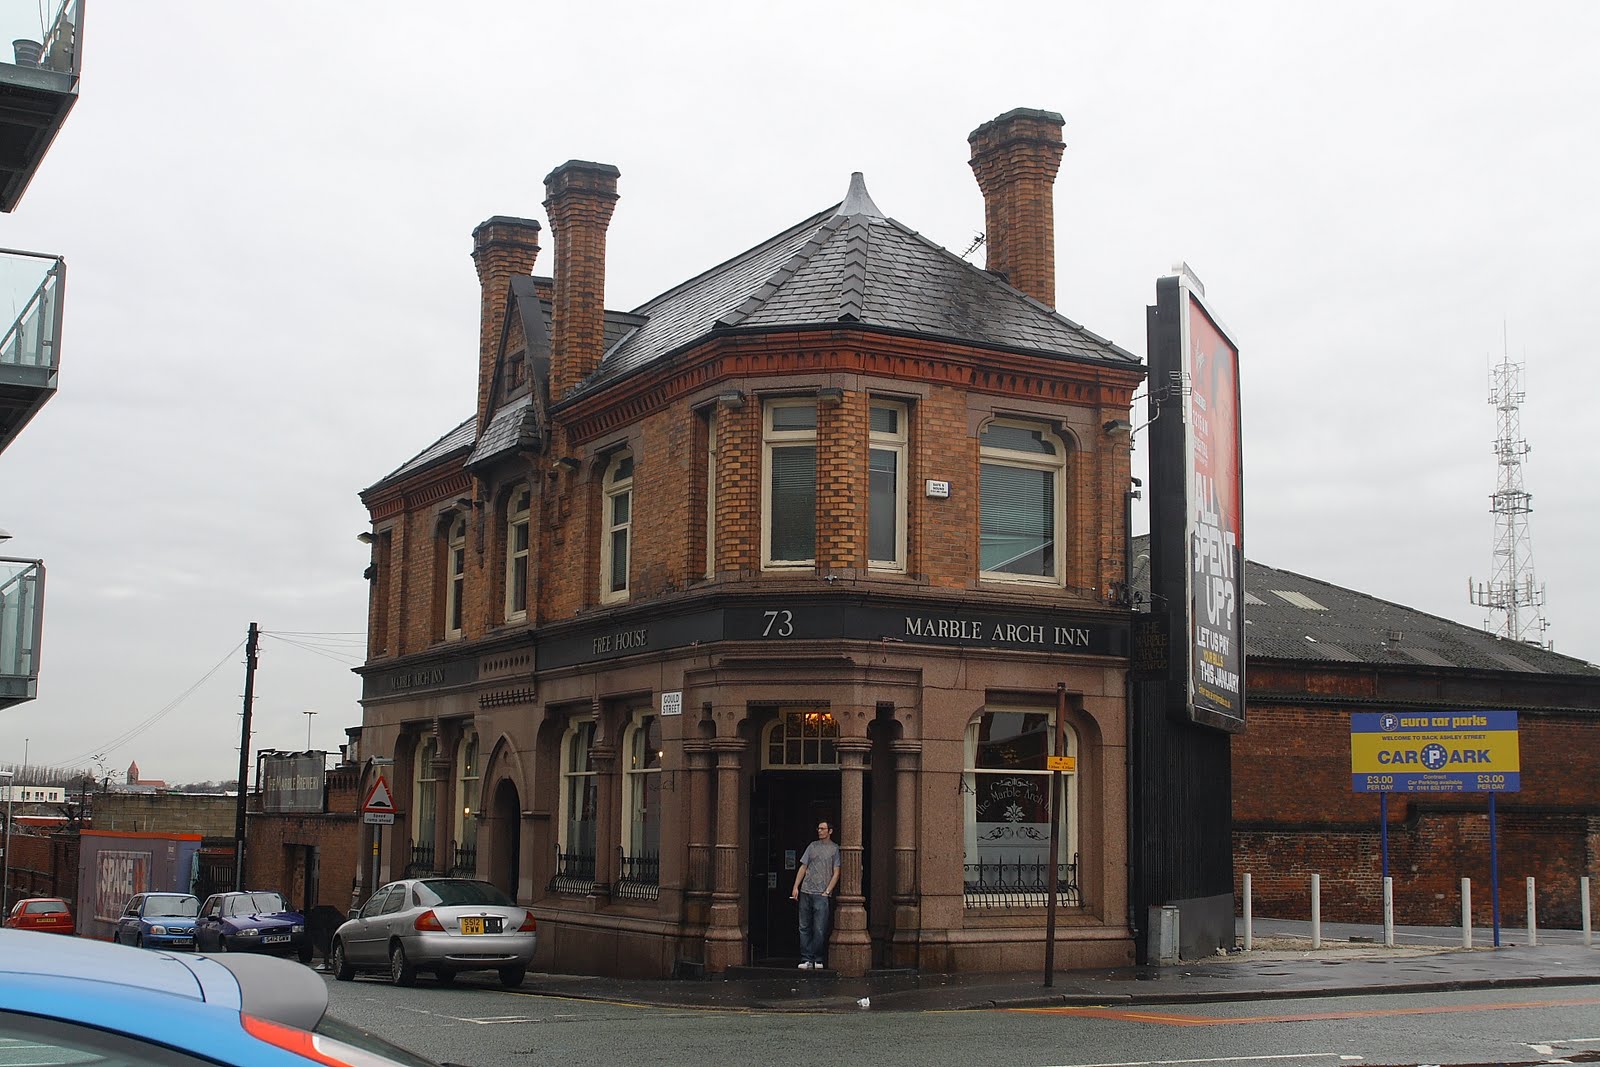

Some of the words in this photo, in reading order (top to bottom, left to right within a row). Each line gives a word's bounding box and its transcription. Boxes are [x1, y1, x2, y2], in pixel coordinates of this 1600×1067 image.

[1195, 472, 1218, 527] ALL
[1195, 521, 1236, 579] SPENT
[1206, 576, 1235, 630] UP?
[762, 610, 794, 637] 73
[905, 616, 982, 640] MARBLE
[991, 623, 1045, 644] ARCH
[1053, 626, 1091, 646] INN
[592, 635, 612, 654] FREE
[615, 629, 647, 651] HOUSE
[1197, 625, 1210, 649] LET
[1210, 630, 1219, 653] US
[1219, 633, 1230, 656] PAY
[1200, 659, 1215, 685] THIS
[662, 703, 680, 714] STREET
[663, 694, 680, 704] GOULD
[1400, 717, 1428, 727] euro
[1431, 717, 1449, 727] car
[1452, 714, 1487, 729] parks
[1377, 750, 1418, 764] CAR
[1367, 775, 1393, 784] £3.00
[1477, 774, 1505, 783] £3.00
[976, 800, 991, 815] The
[991, 786, 1021, 802] Marble
[1024, 788, 1044, 805] Arch
[101, 857, 134, 895] SPACE
